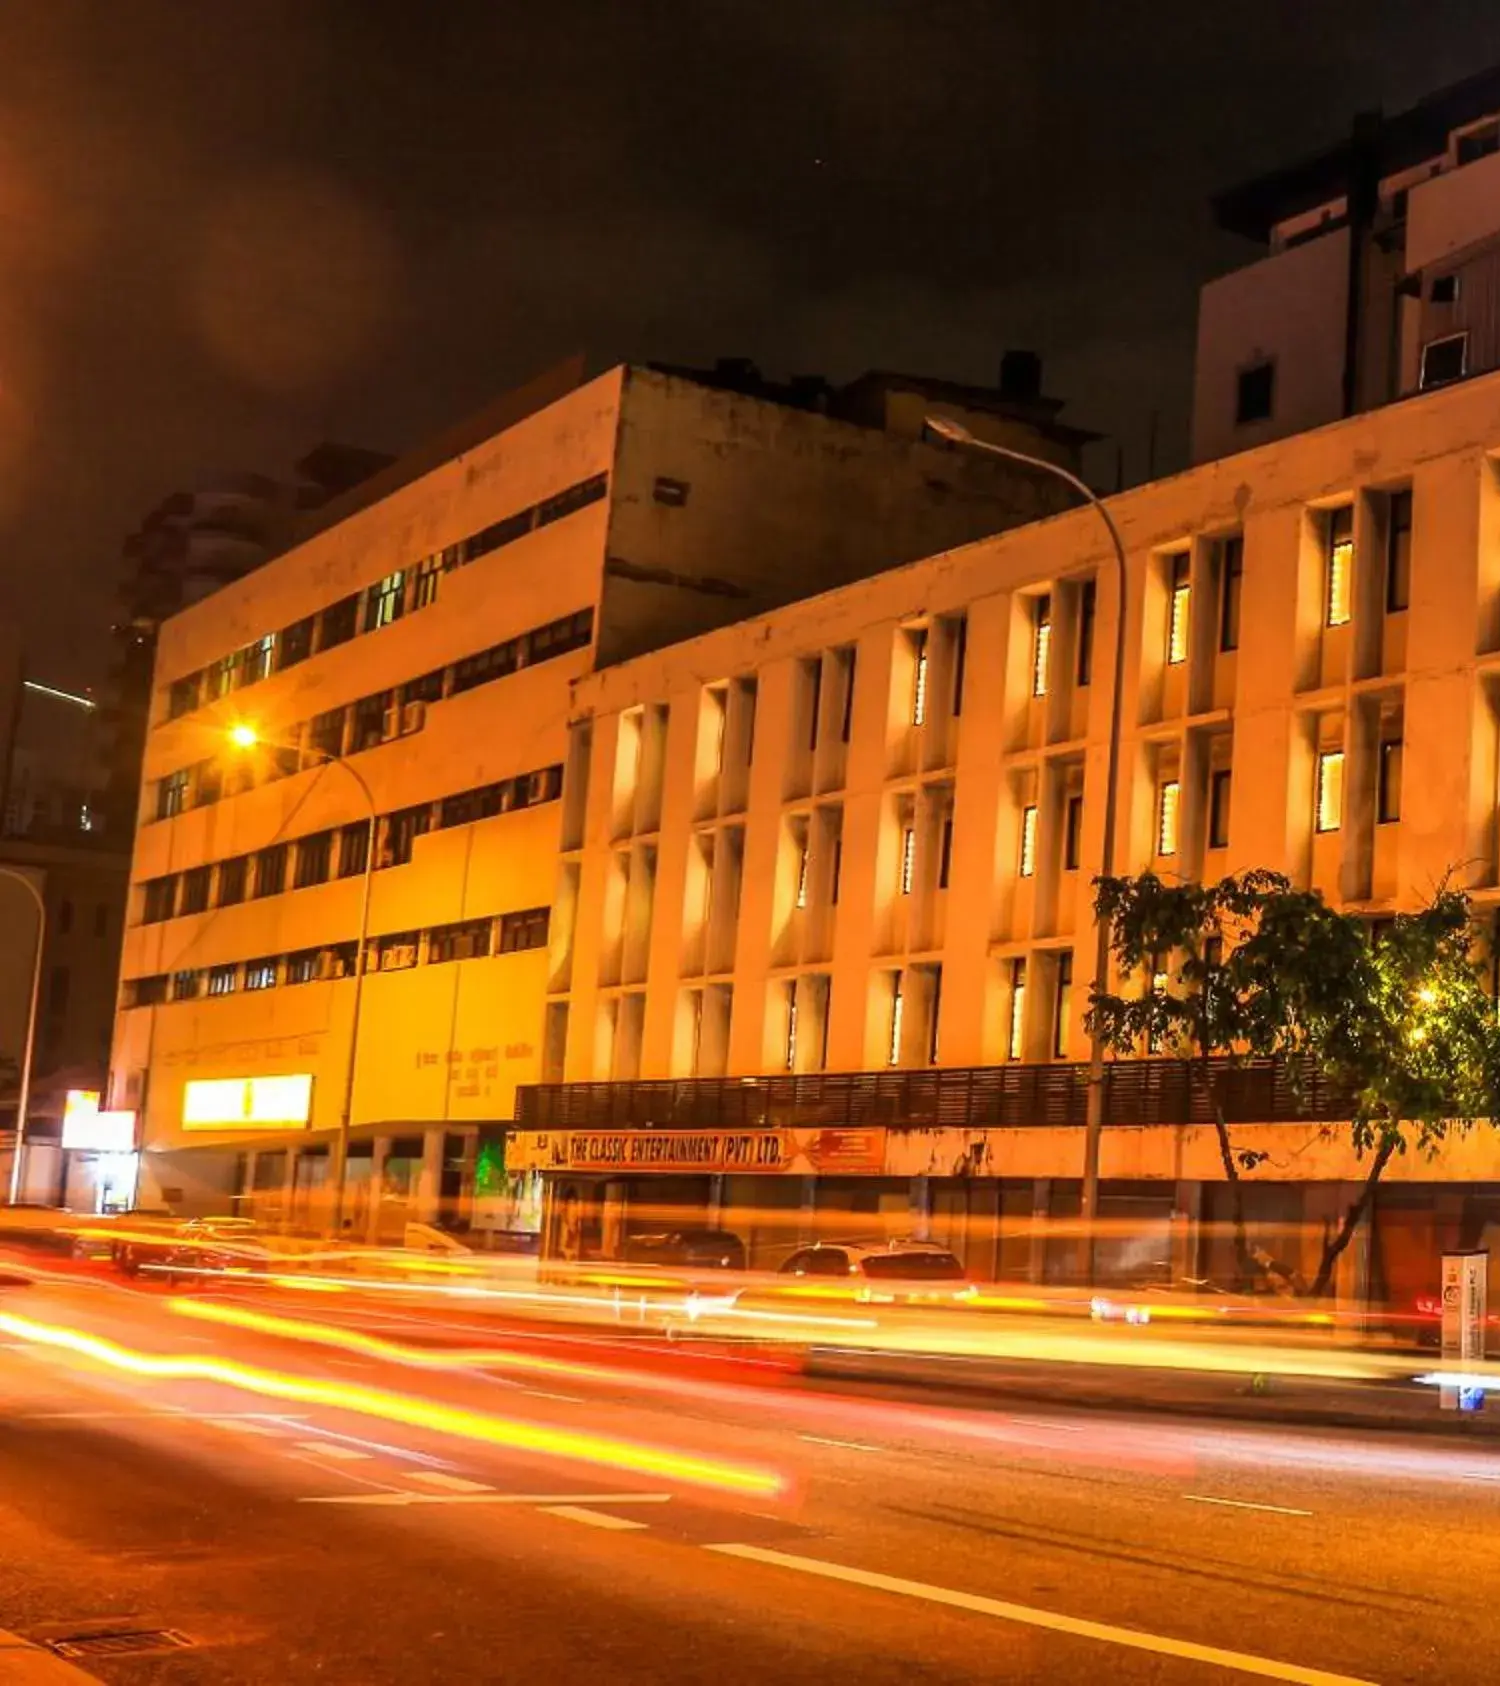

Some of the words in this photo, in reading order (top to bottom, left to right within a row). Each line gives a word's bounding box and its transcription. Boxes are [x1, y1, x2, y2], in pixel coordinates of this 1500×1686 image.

[571, 1136, 587, 1162] THE
[590, 1136, 627, 1162] CLASSIC
[631, 1136, 719, 1163] ENTERTAINMENT
[723, 1136, 753, 1165] (PVT)
